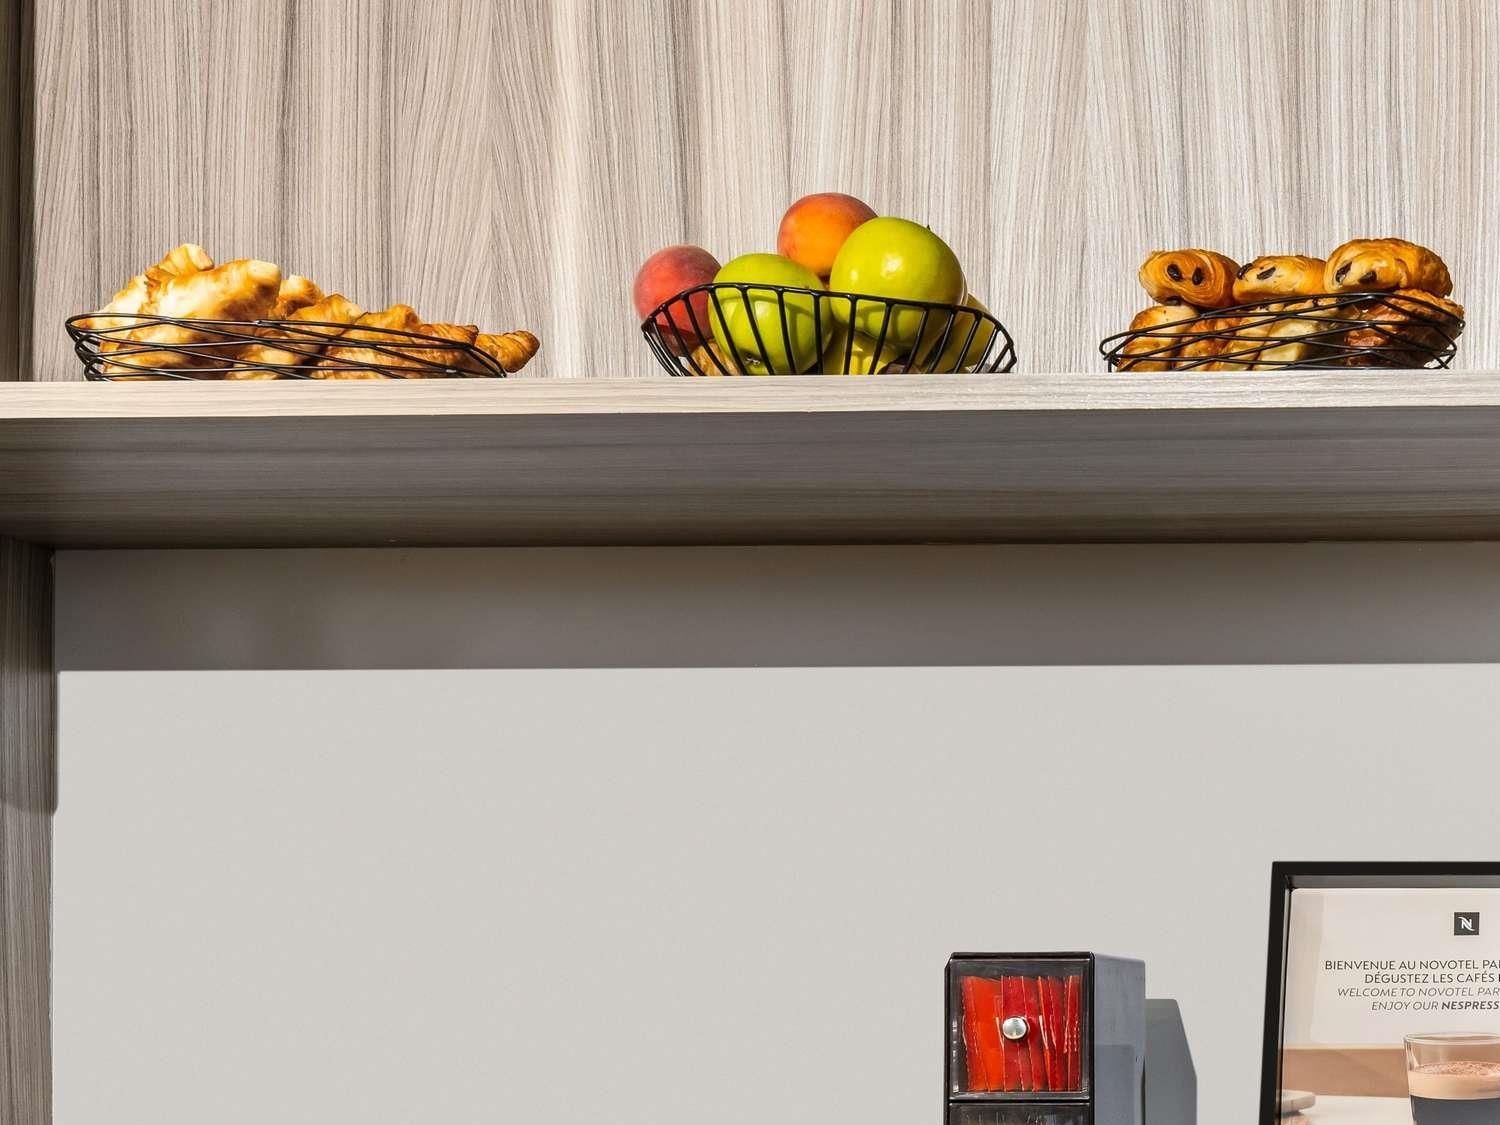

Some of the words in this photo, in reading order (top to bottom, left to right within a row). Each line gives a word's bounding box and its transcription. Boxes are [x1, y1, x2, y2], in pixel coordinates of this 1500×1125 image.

[1325, 960, 1396, 970] BIENVENUE
[1398, 960, 1416, 970] AU
[1419, 959, 1479, 970] NOVOTEL
[1364, 971, 1429, 984] DÉGUSTEZ
[1432, 973, 1454, 983] LES
[1456, 970, 1495, 983] CAFÉS
[1337, 987, 1398, 997] WELCOME
[1399, 987, 1416, 997] TO
[1418, 987, 1475, 997] NOVOTEL
[1371, 1001, 1411, 1011] ENJOY
[1412, 1000, 1439, 1011] OUR
